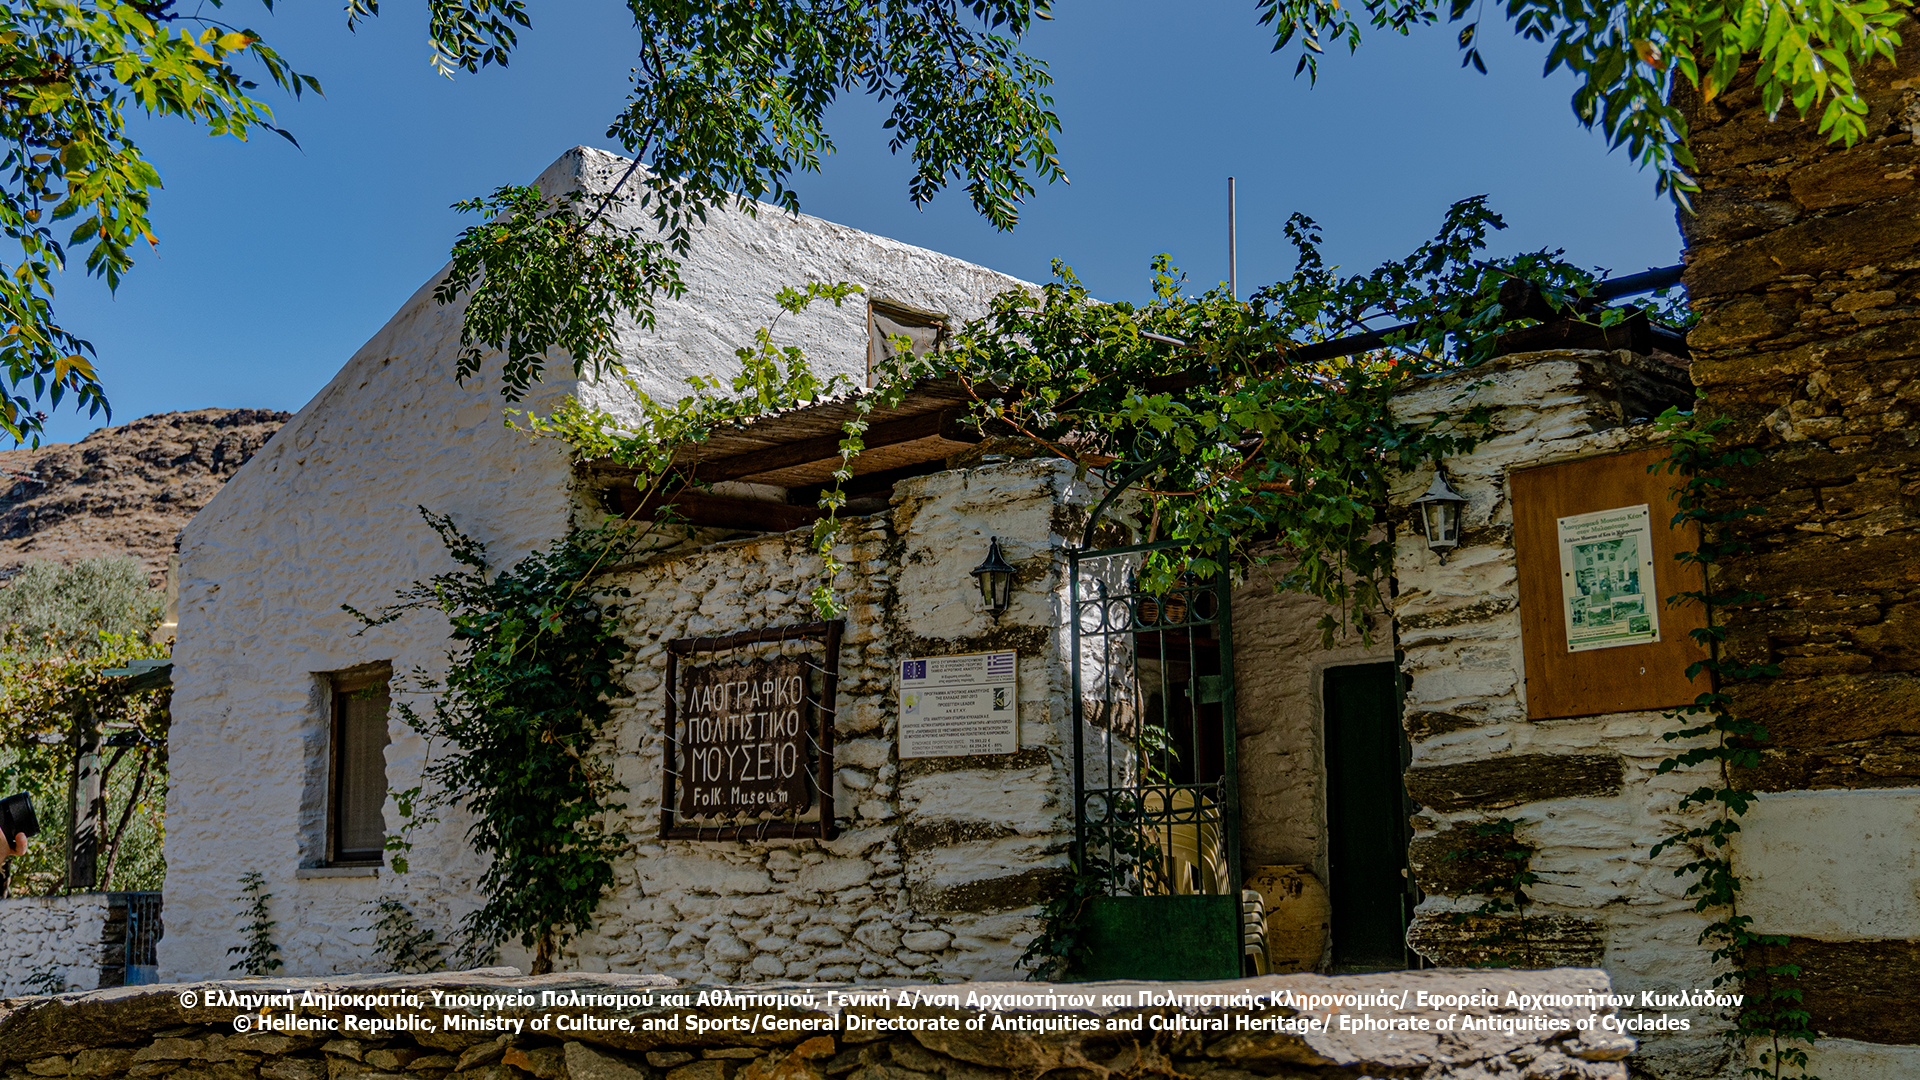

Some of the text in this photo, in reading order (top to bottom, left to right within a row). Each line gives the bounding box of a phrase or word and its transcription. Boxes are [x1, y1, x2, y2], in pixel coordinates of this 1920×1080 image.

[689, 675, 803, 713] ΛΑΟΓΡΑΦΙΚΟ
[688, 710, 799, 744] ΠΟΛΙΤΙΣΤΙΚΟ
[691, 742, 796, 782] ΜΟΥΣΕΙΟ
